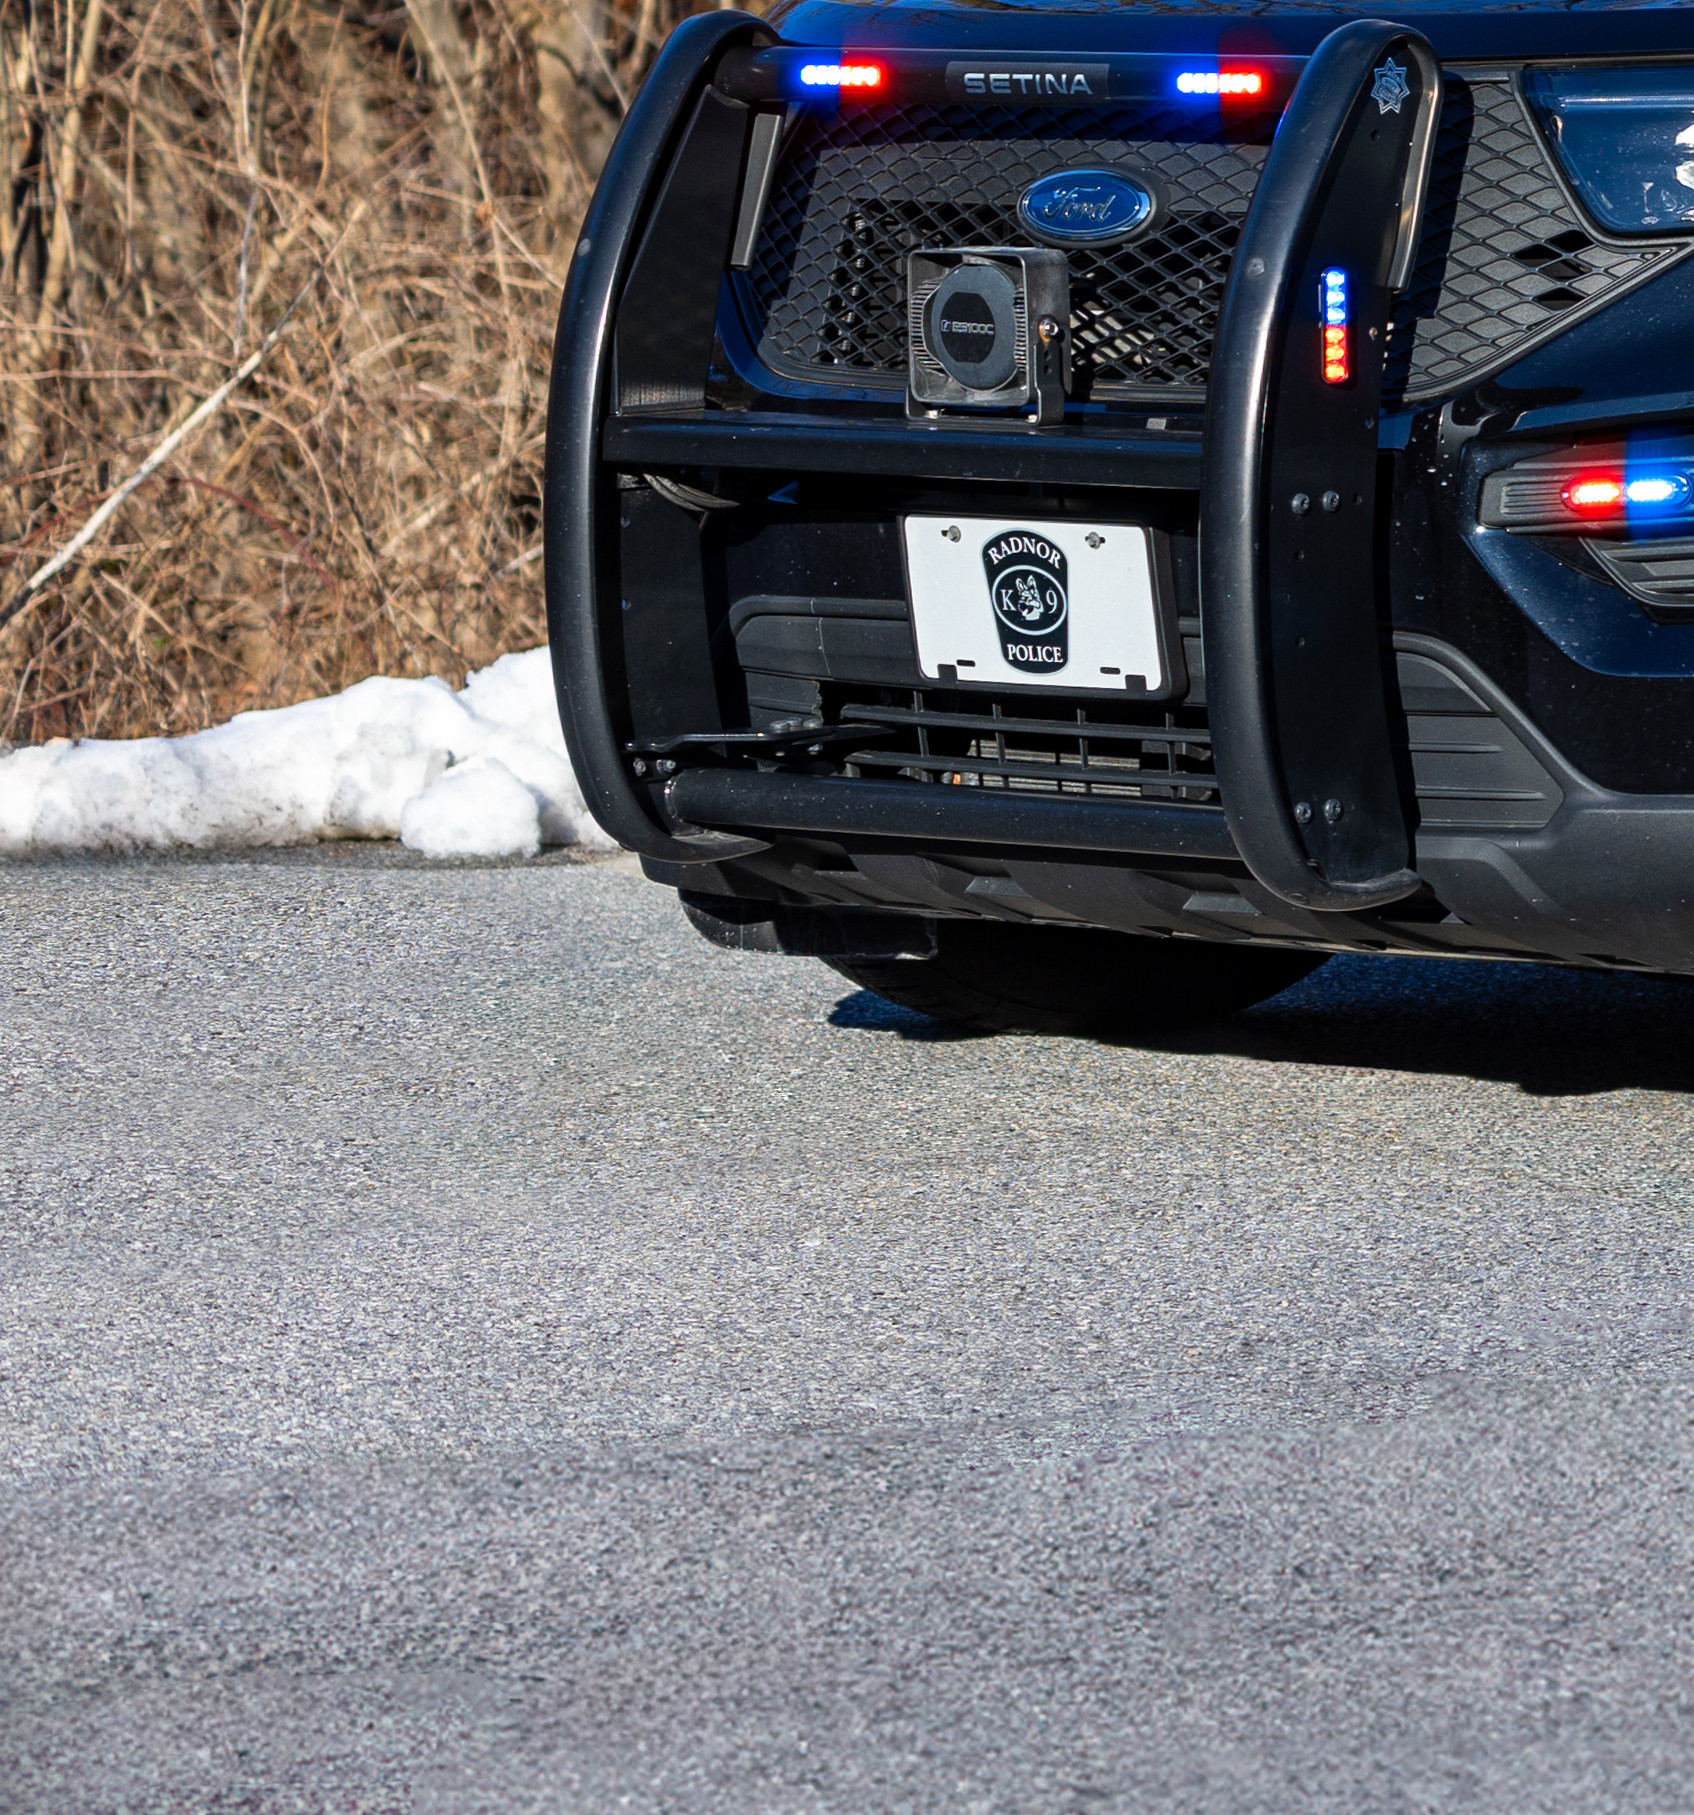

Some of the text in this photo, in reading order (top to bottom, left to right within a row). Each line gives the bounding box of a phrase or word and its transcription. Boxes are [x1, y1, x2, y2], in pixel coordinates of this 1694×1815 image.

[963, 72, 1093, 95] SETINA
[1043, 184, 1117, 222] Ford
[987, 536, 1062, 570] RADNOR
[1000, 588, 1059, 614] K 9
[1006, 643, 1064, 663] POLICE
